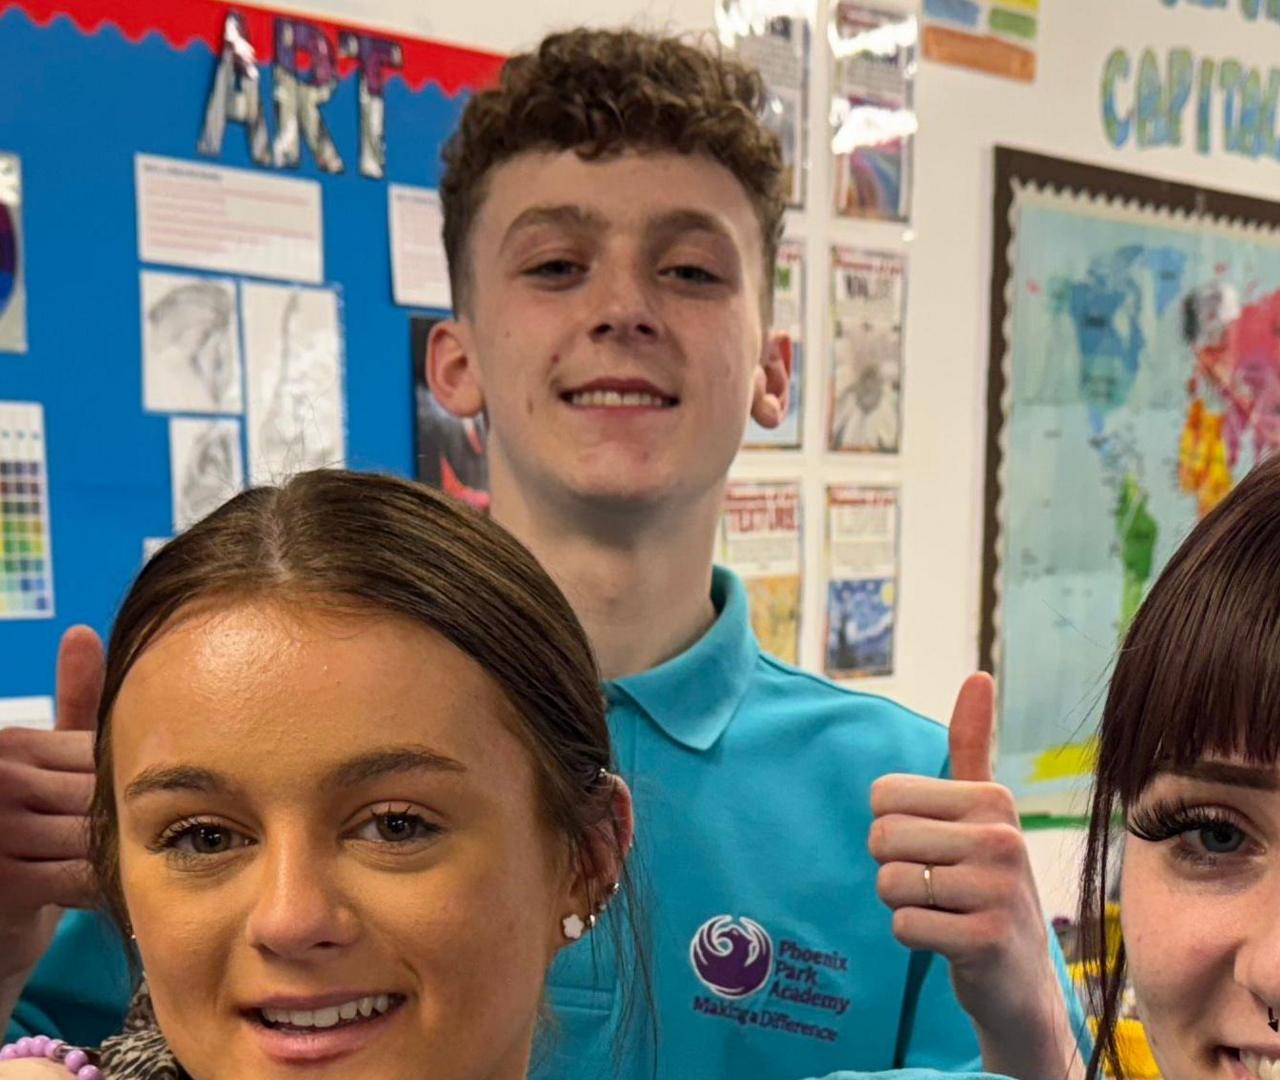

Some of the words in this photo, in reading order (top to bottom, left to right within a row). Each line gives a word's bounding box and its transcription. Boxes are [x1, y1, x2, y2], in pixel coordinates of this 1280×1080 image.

[197, 9, 404, 180] ART
[776, 960, 817, 985] Park
[779, 939, 848, 971] Phoenix
[770, 980, 851, 1015] Academy
[692, 996, 749, 1025] Making
[749, 1011, 758, 1023] a
[760, 1010, 838, 1042] Difference
